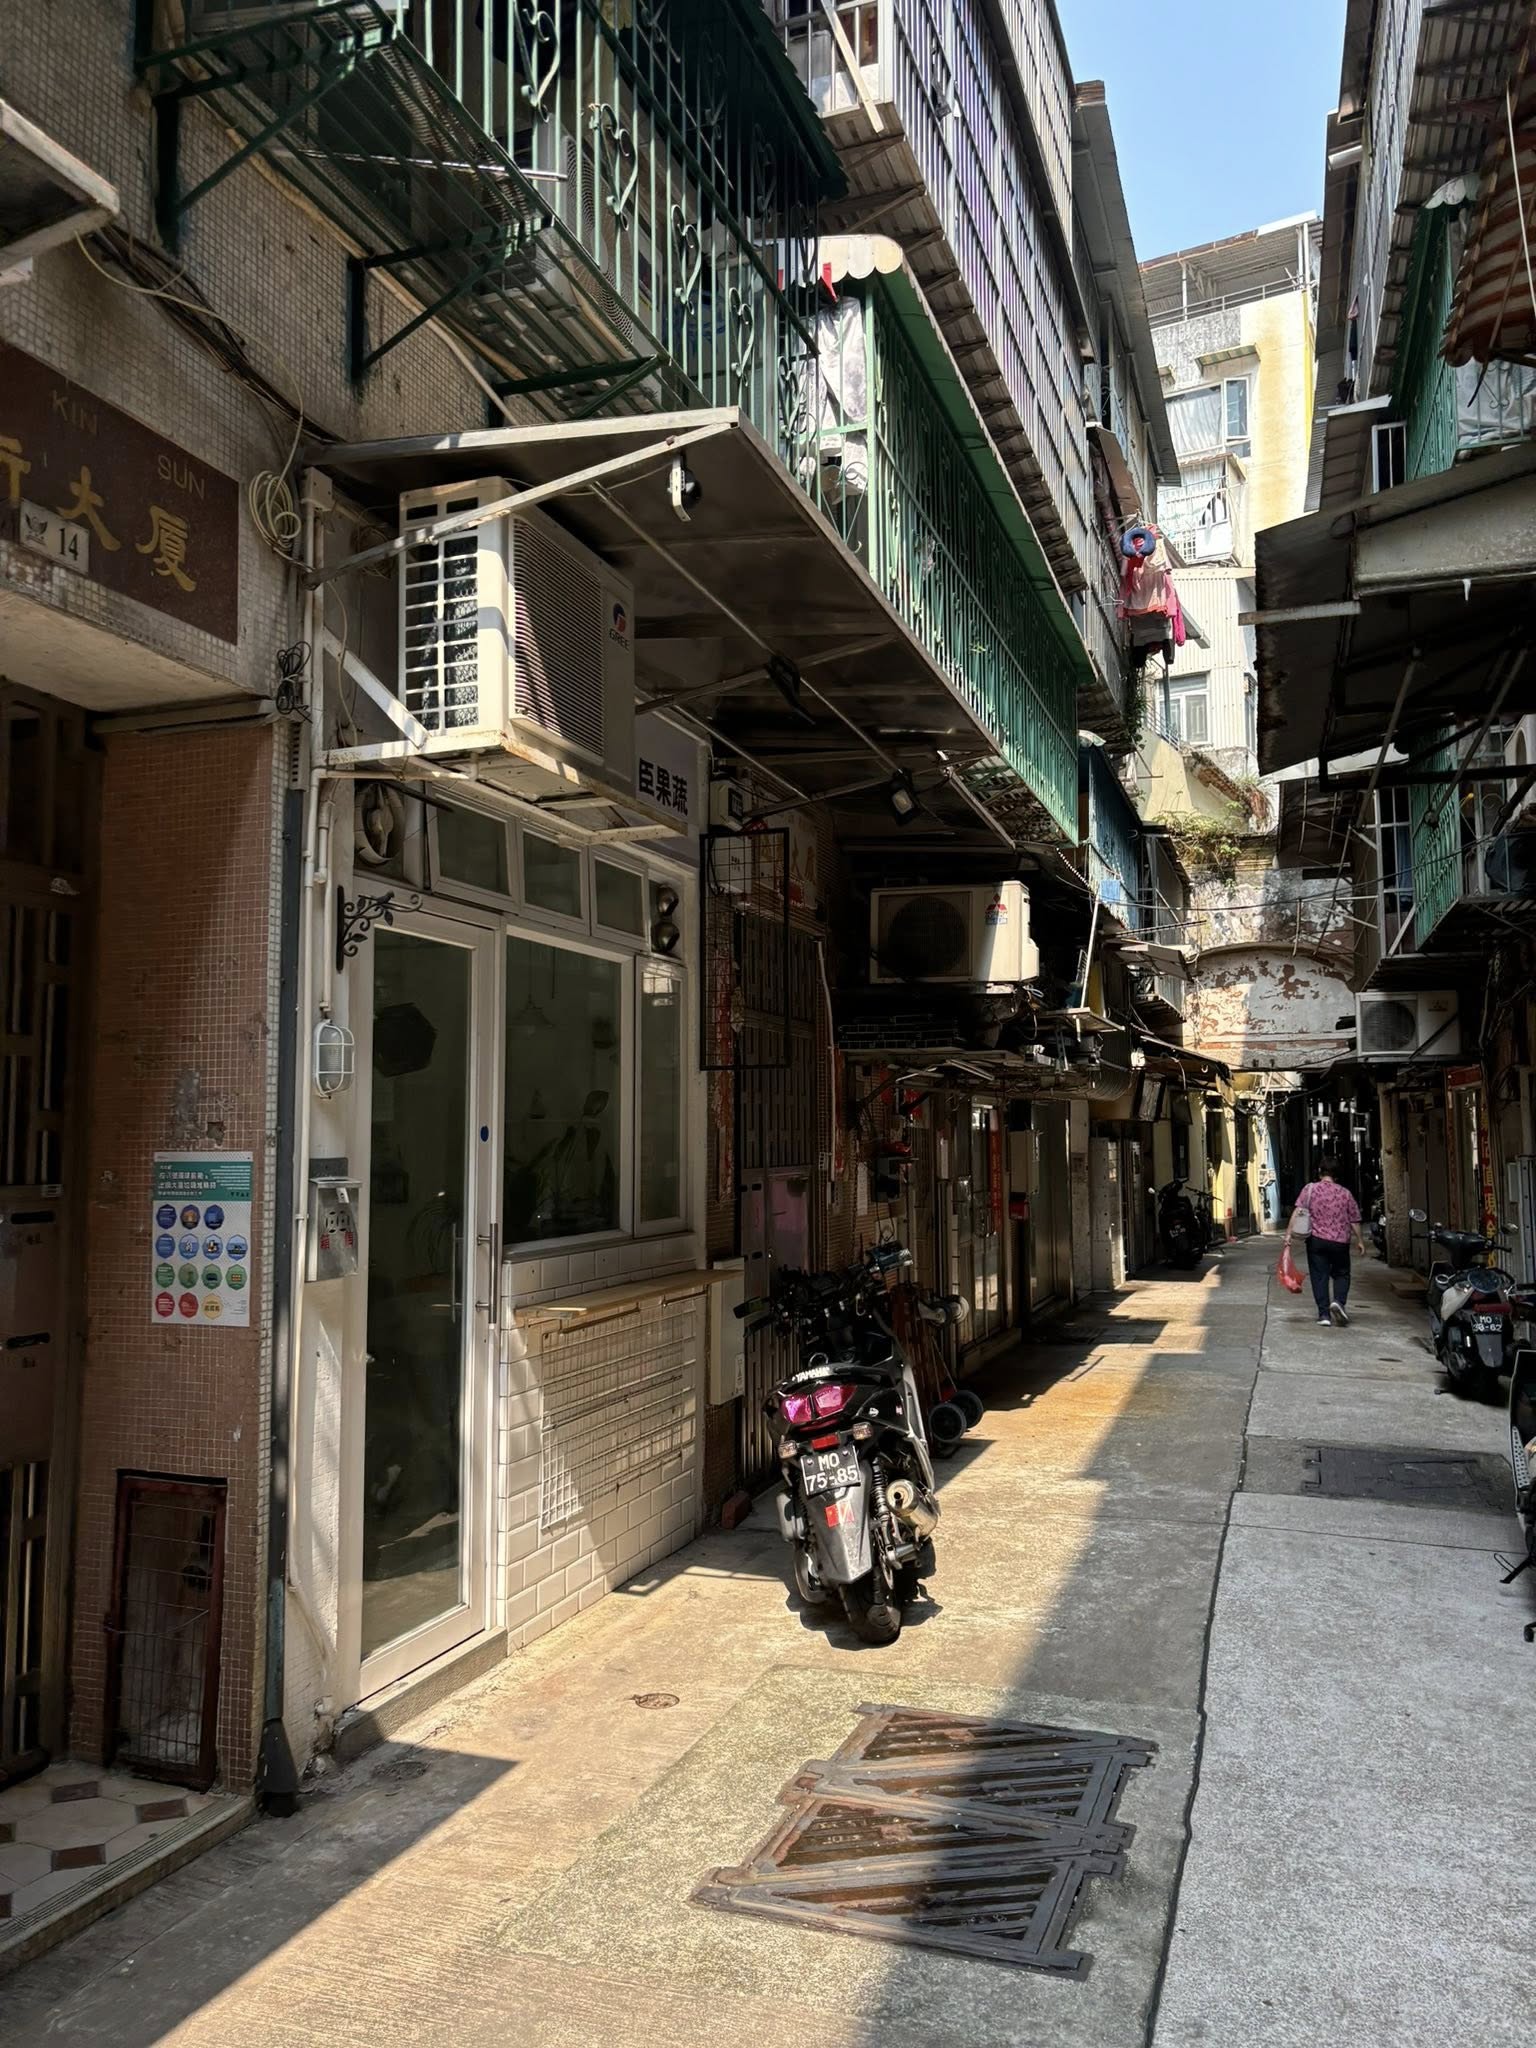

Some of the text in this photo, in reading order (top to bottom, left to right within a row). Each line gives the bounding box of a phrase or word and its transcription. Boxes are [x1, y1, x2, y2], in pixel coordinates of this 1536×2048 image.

[53, 389, 205, 500] KIN SUN
[58, 526, 79, 562] 14
[638, 757, 688, 816] 臣果蔬
[796, 1366, 829, 1383] YAMAHA
[817, 1452, 840, 1471] MO
[806, 1464, 858, 1492] 75-85
